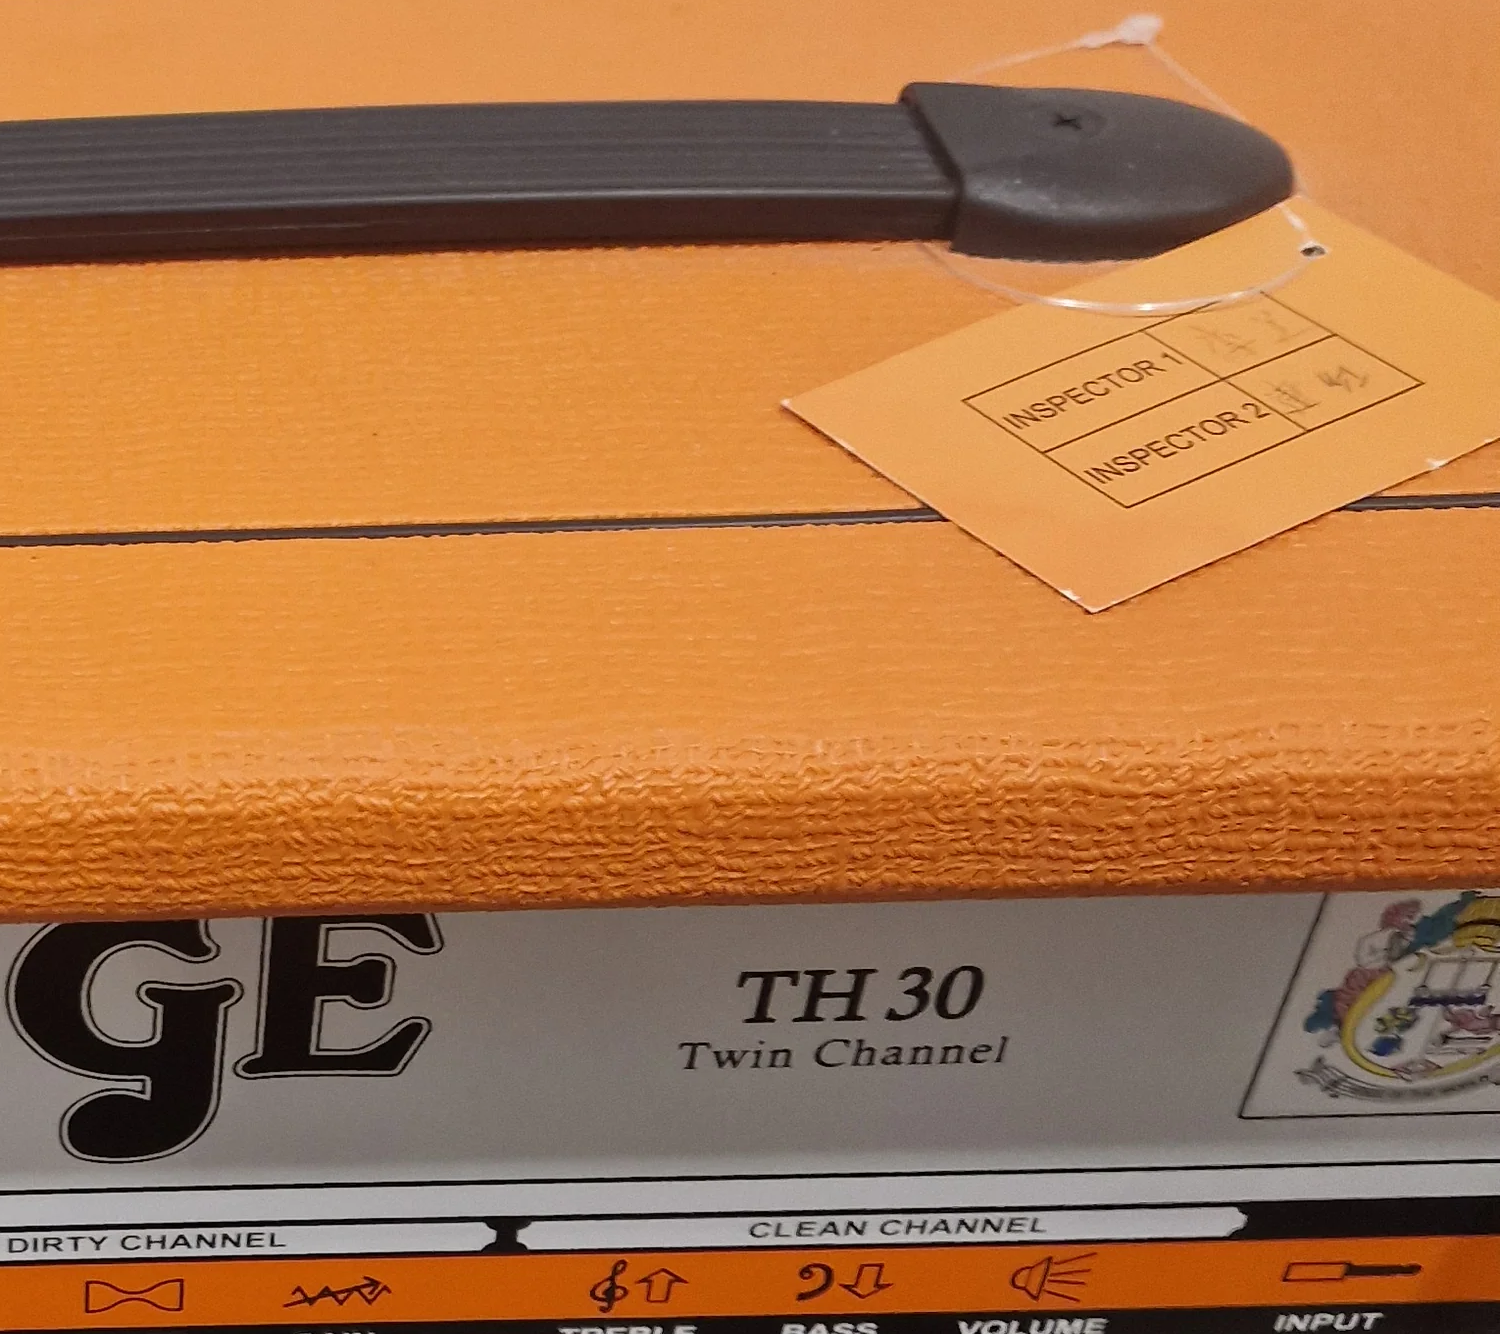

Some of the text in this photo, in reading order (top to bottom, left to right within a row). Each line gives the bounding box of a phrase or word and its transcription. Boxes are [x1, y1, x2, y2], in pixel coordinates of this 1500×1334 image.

[1002, 351, 1183, 430] INSPECTOR 1
[1083, 402, 1271, 484] INSPECTOR 2
[736, 965, 984, 1024] TH 30
[678, 1035, 1010, 1070] Twin Channel
[7, 1231, 287, 1254] DIRTY CHANNEL
[748, 1216, 1046, 1238] CLEAN CHANNEL
[1273, 1312, 1383, 1334] INPUT
